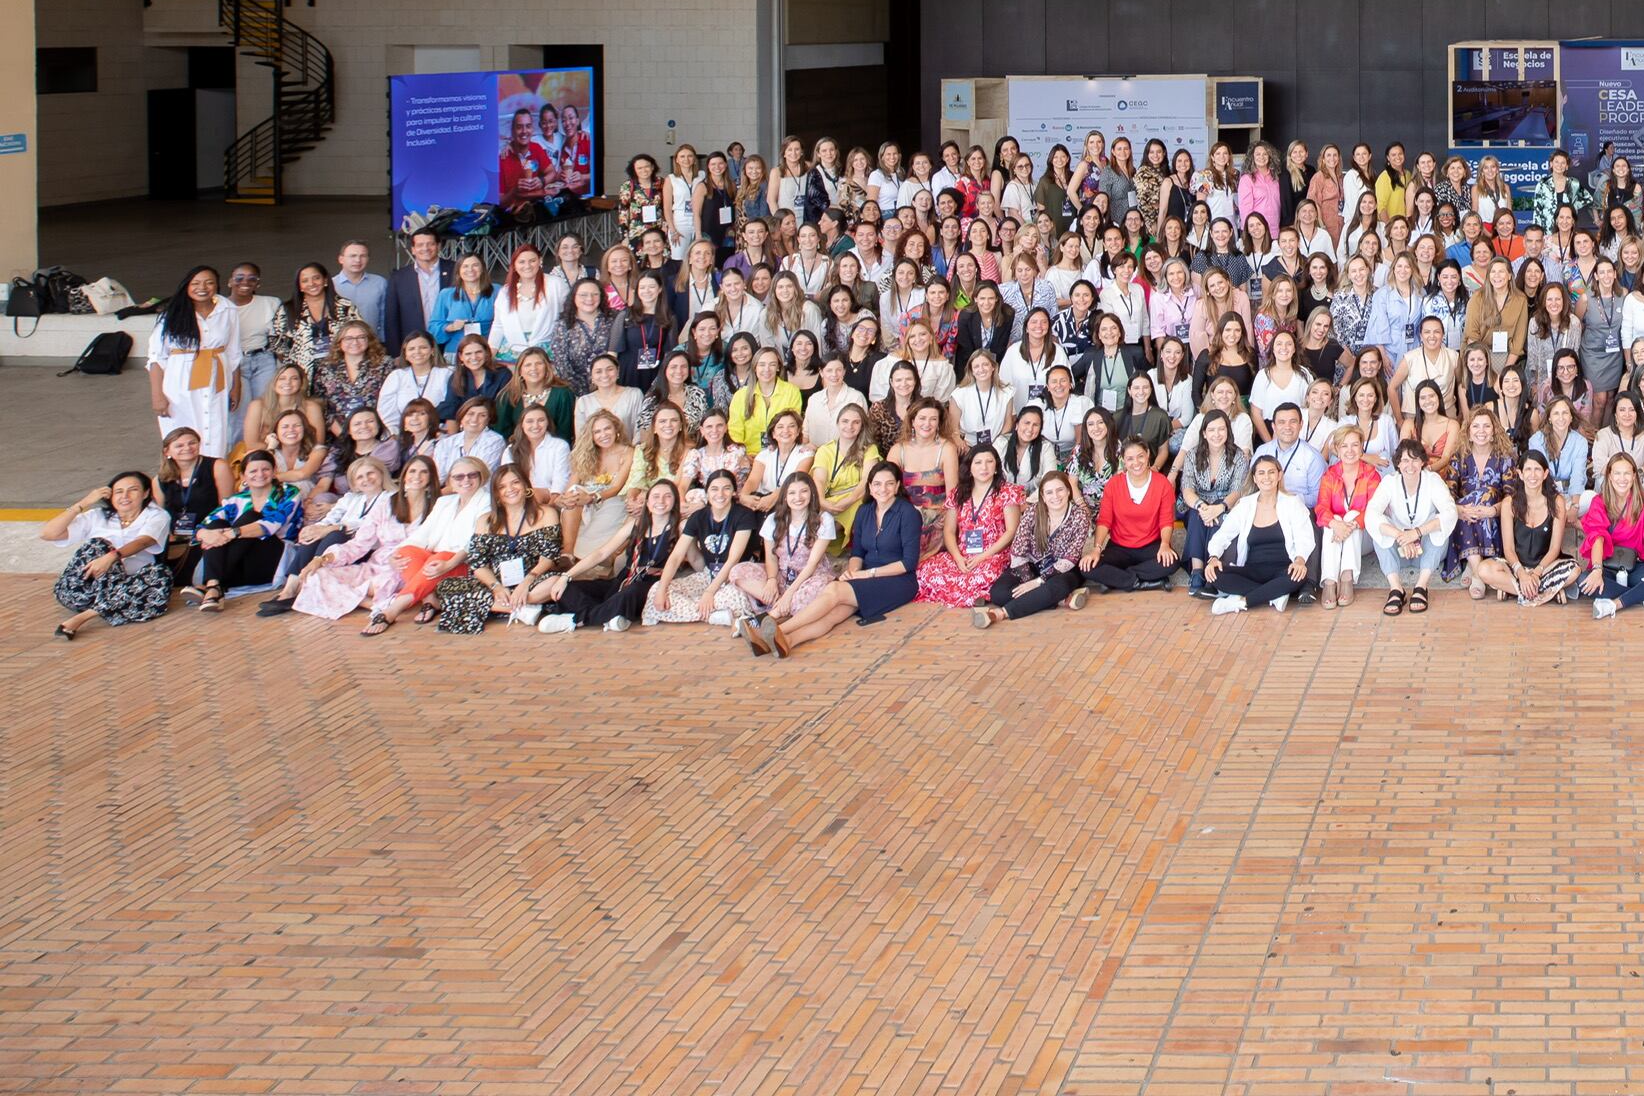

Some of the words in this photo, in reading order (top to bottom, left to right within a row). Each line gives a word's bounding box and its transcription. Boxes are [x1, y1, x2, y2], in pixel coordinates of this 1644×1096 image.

[1503, 51, 1538, 60] Escela
[1540, 51, 1552, 60] de
[1503, 60, 1545, 69] Negcios
[1599, 89, 1638, 100] CESA
[1500, 171, 1548, 184] egocios
